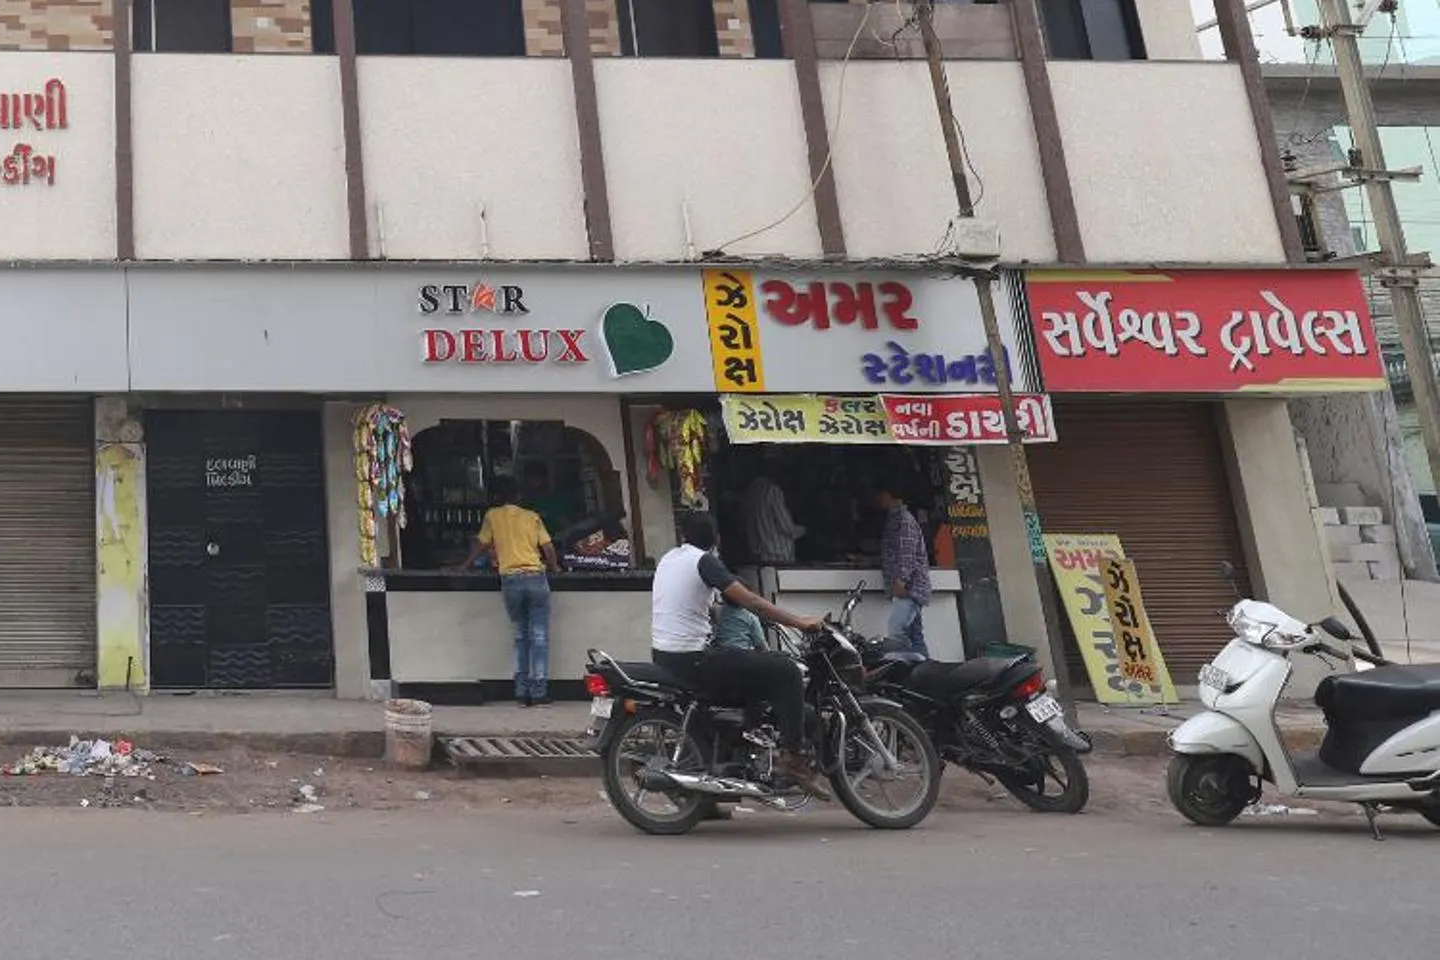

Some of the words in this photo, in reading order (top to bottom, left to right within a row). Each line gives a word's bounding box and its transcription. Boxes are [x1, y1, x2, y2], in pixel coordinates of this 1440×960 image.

[761, 279, 919, 331] અમર
[424, 329, 589, 362] DELUX
[714, 271, 758, 386] ઝેરોક્ષ
[1041, 290, 1209, 357] સર્વેશ્વર
[1219, 290, 1368, 372] ટ્રાવેલ્સ
[737, 401, 806, 435] ઝેરોક્ષ
[818, 414, 887, 437] ઝેરોક્ષ
